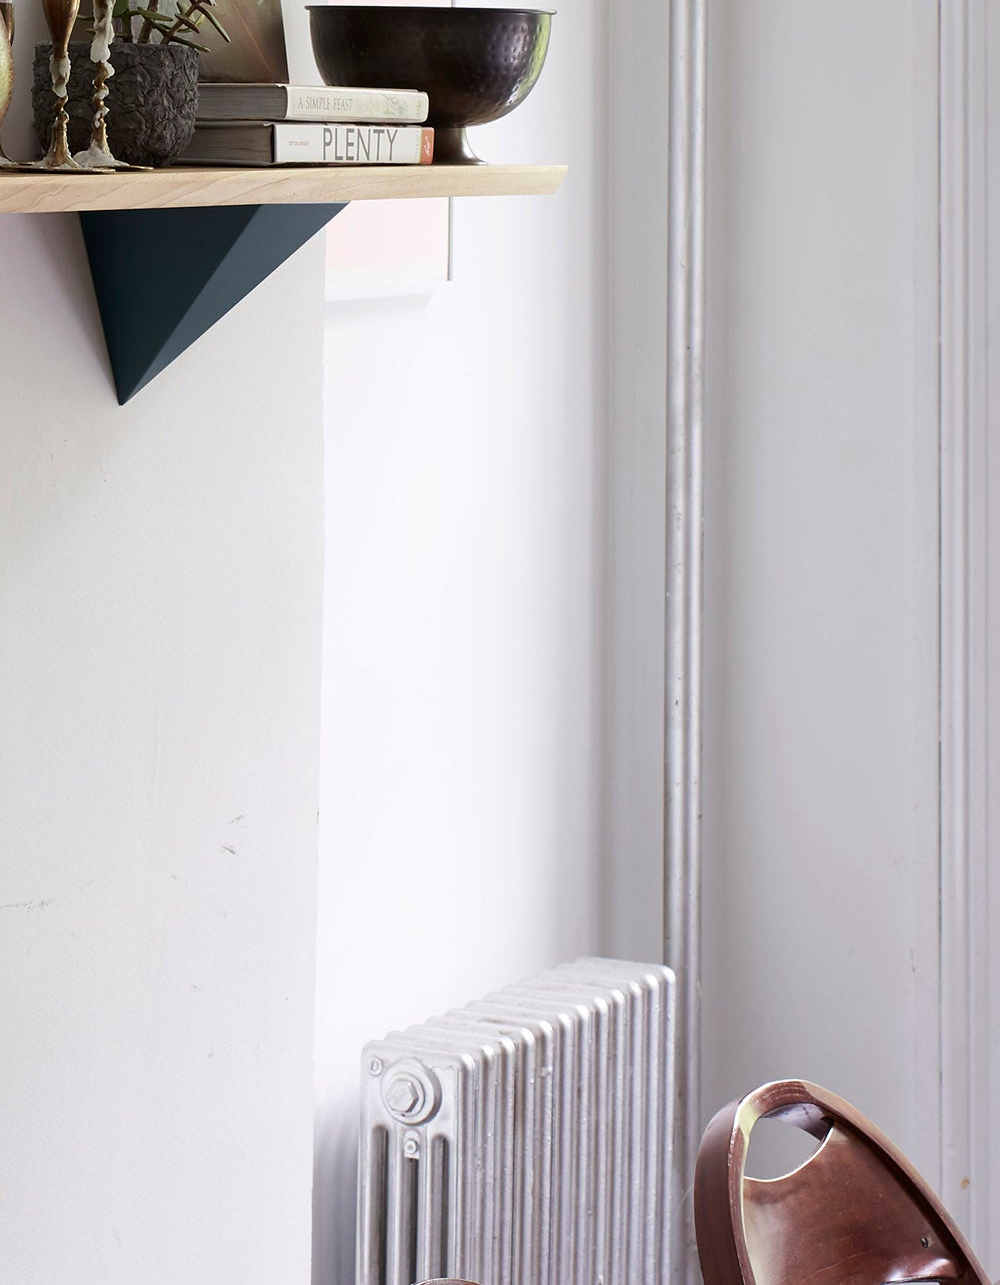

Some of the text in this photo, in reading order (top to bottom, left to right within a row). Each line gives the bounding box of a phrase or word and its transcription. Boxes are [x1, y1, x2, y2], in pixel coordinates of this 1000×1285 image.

[297, 98, 304, 110] A
[306, 96, 331, 111] SIMPLE
[333, 98, 353, 111] FEAST
[323, 127, 399, 161] PLENTY
